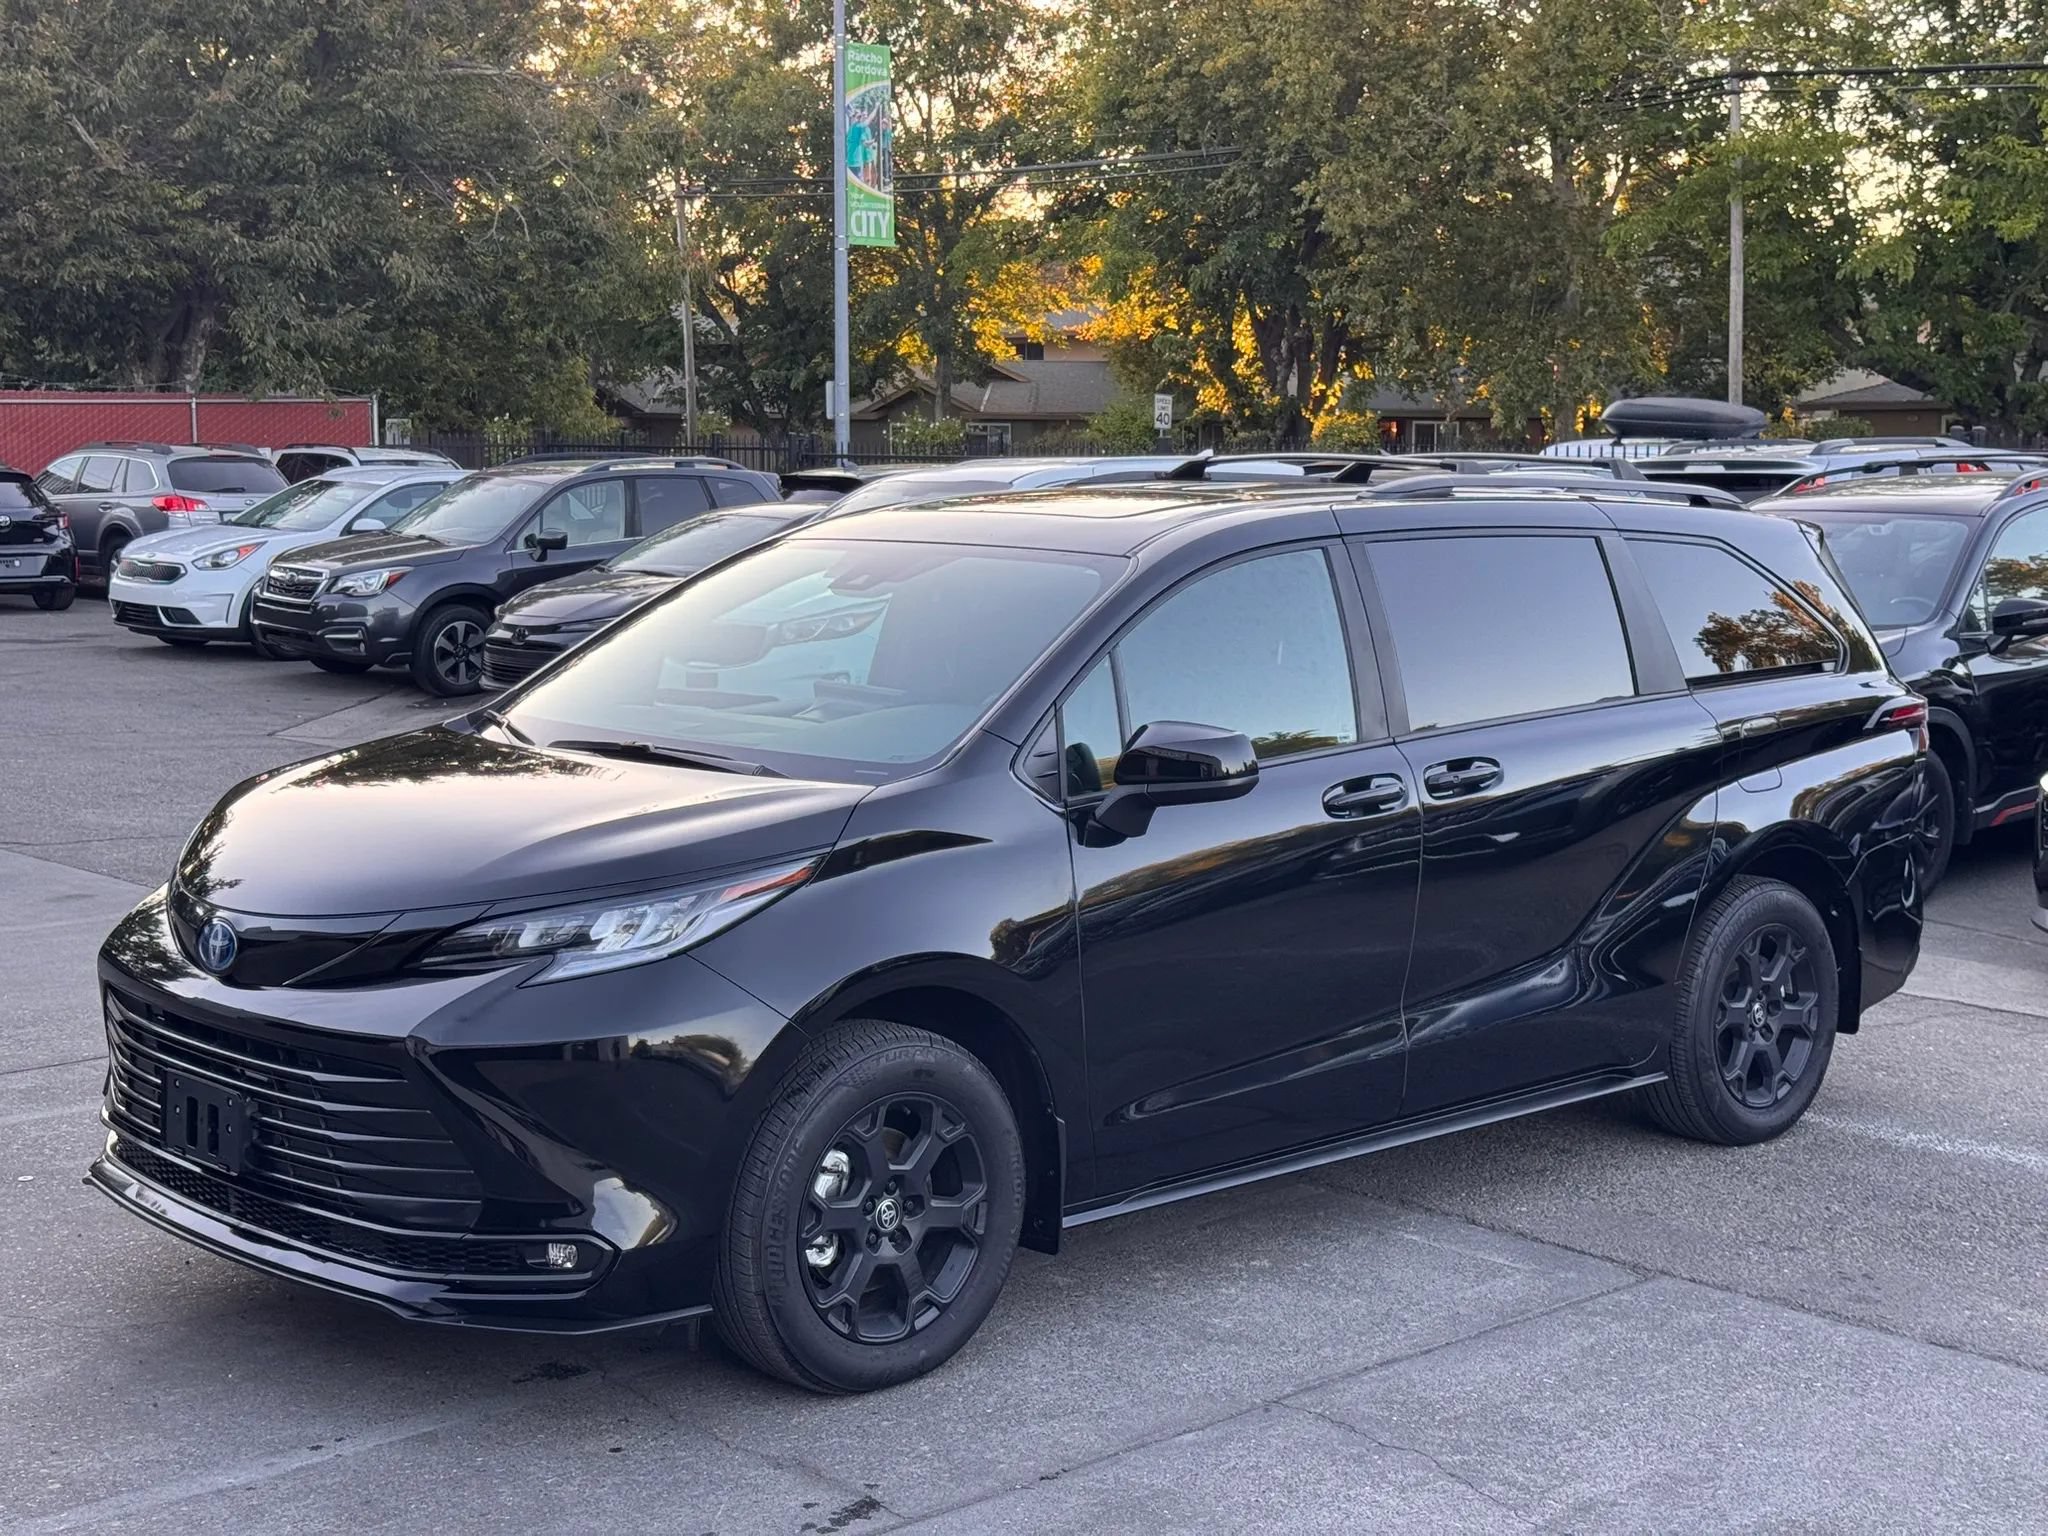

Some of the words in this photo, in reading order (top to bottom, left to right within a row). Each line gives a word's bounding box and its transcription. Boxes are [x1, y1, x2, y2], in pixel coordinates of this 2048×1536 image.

[848, 50, 883, 64] Rancho
[848, 62, 888, 77] Cordova
[850, 210, 890, 238] CITY
[1156, 412, 1170, 425] 40
